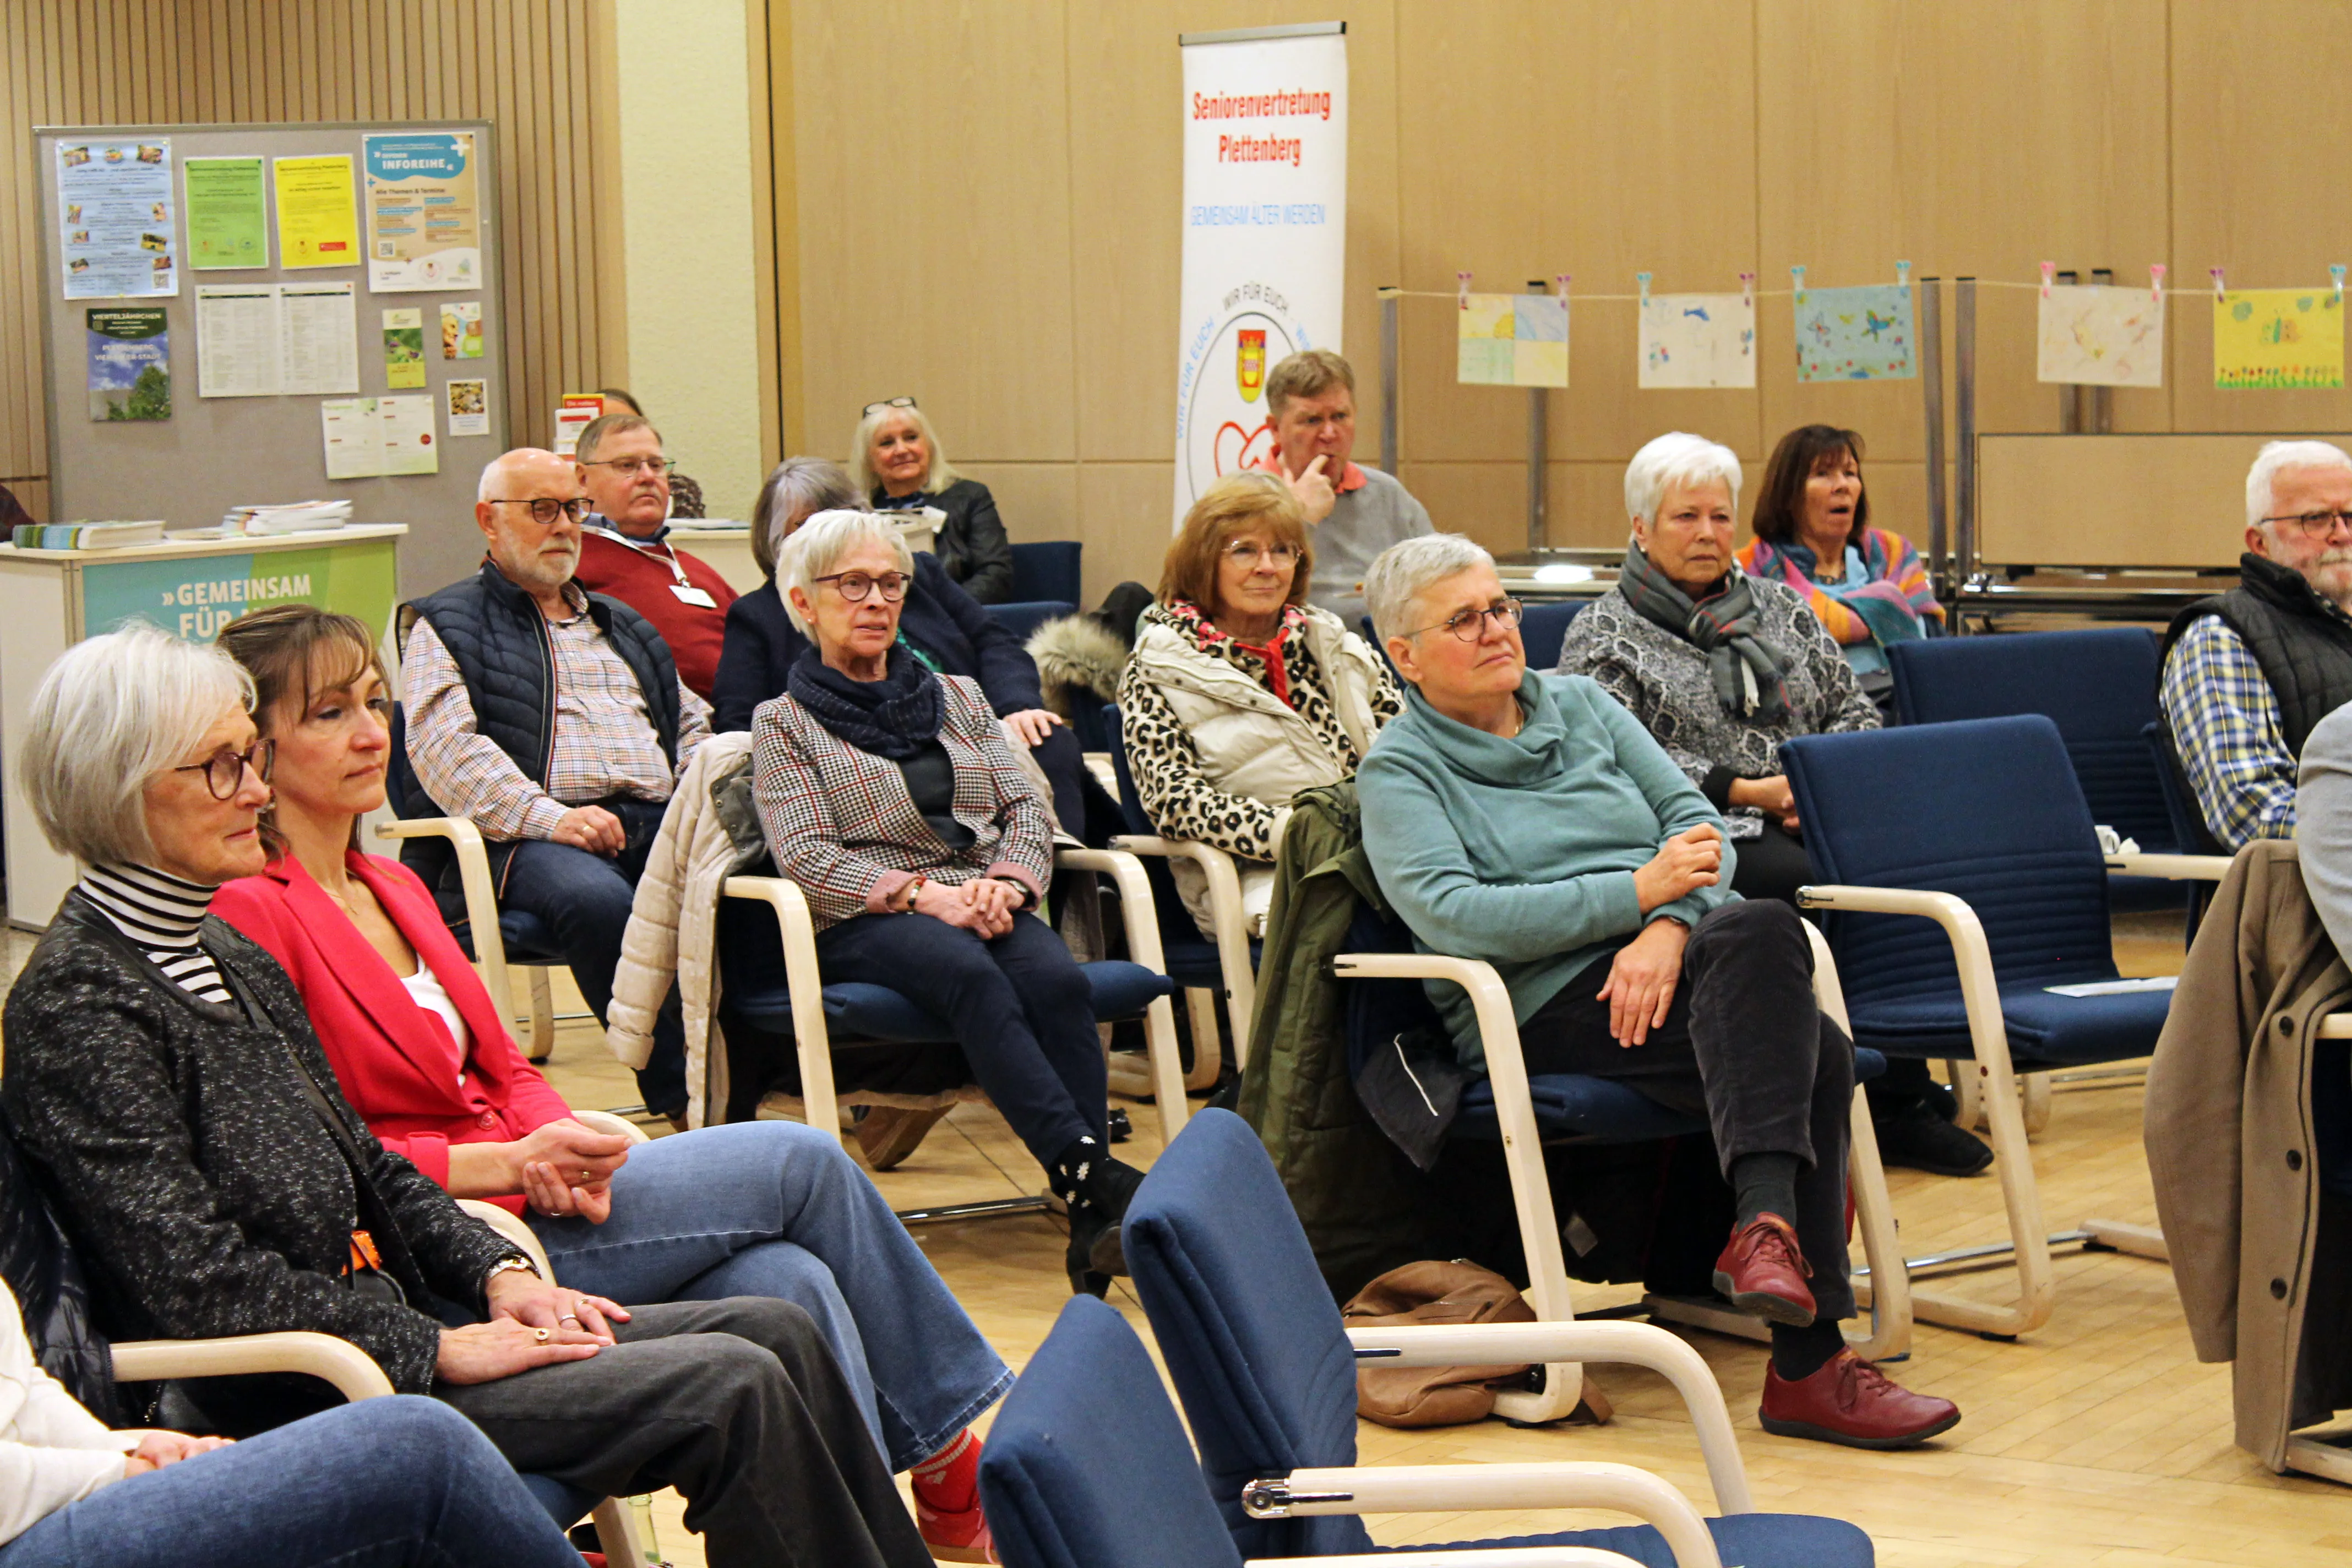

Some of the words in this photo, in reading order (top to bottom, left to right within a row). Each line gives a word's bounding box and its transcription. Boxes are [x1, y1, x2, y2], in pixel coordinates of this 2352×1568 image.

[1193, 88, 1330, 121] Seniorenvertretung
[382, 159, 445, 170] INFOREIHE
[1218, 133, 1301, 167] Plettenberg
[1190, 205, 1249, 225] GEMEINSAM
[1264, 286, 1289, 316] EUCH
